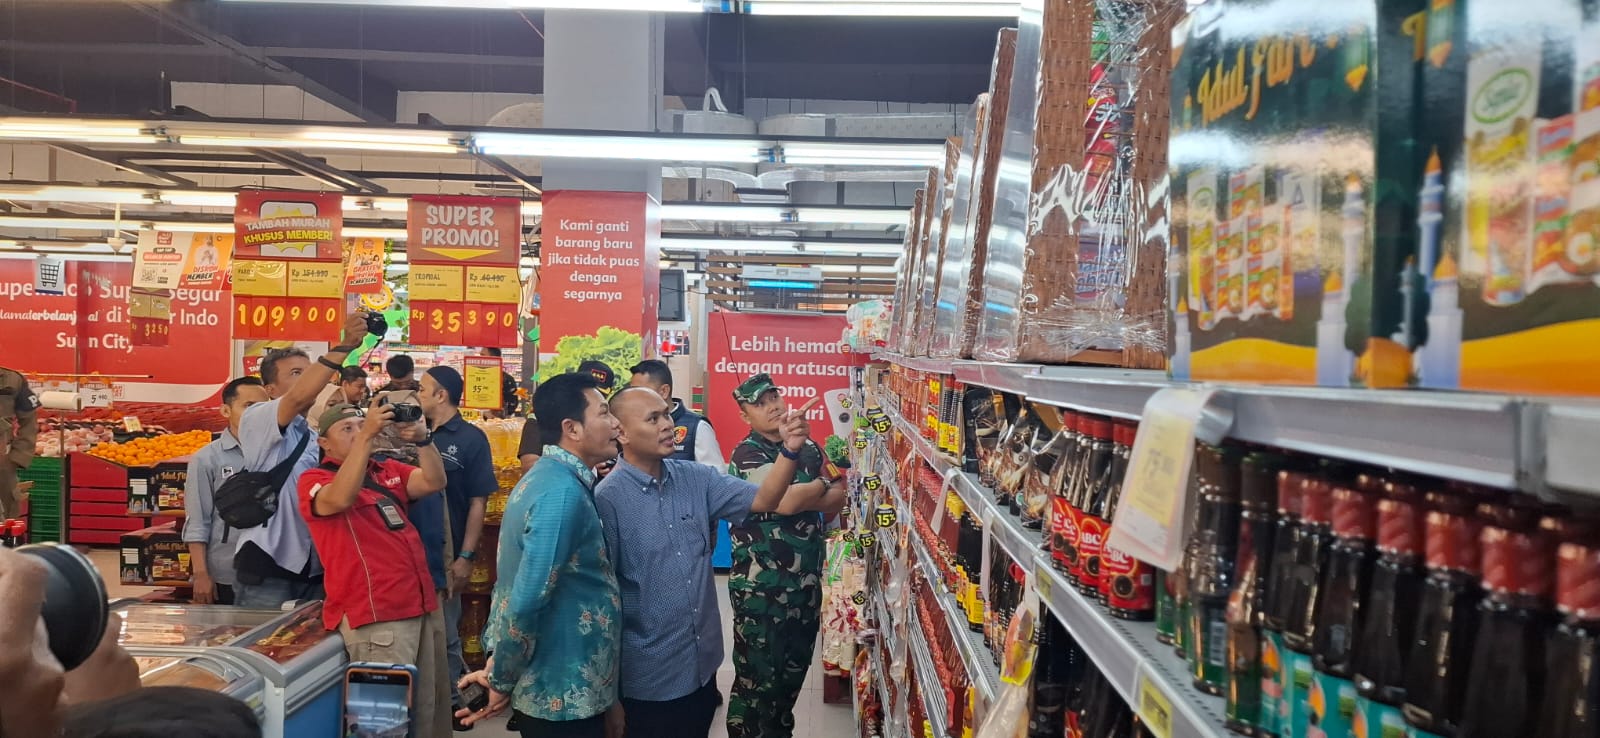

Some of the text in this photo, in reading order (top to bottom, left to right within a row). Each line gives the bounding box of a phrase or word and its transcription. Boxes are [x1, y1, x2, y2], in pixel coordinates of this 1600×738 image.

[426, 204, 495, 226] SUPER
[245, 218, 331, 231] TAMBAH MURAH
[560, 219, 629, 234] Kami ganti
[244, 230, 333, 244] KHUSUS MEMBER!
[421, 227, 500, 247] PROMO!
[555, 236, 633, 251] barang baru
[547, 252, 640, 269] jika tidak puas
[186, 272, 214, 280] MEMBER
[569, 270, 617, 285] dengan
[564, 290, 622, 303] segarnya
[106, 305, 122, 323] di
[180, 308, 218, 326] Indo
[412, 309, 425, 321] Rp
[730, 335, 844, 354] Lebih hemat
[714, 357, 783, 378] dengan
[777, 386, 817, 398] omo
[877, 514, 896, 526] 15%
